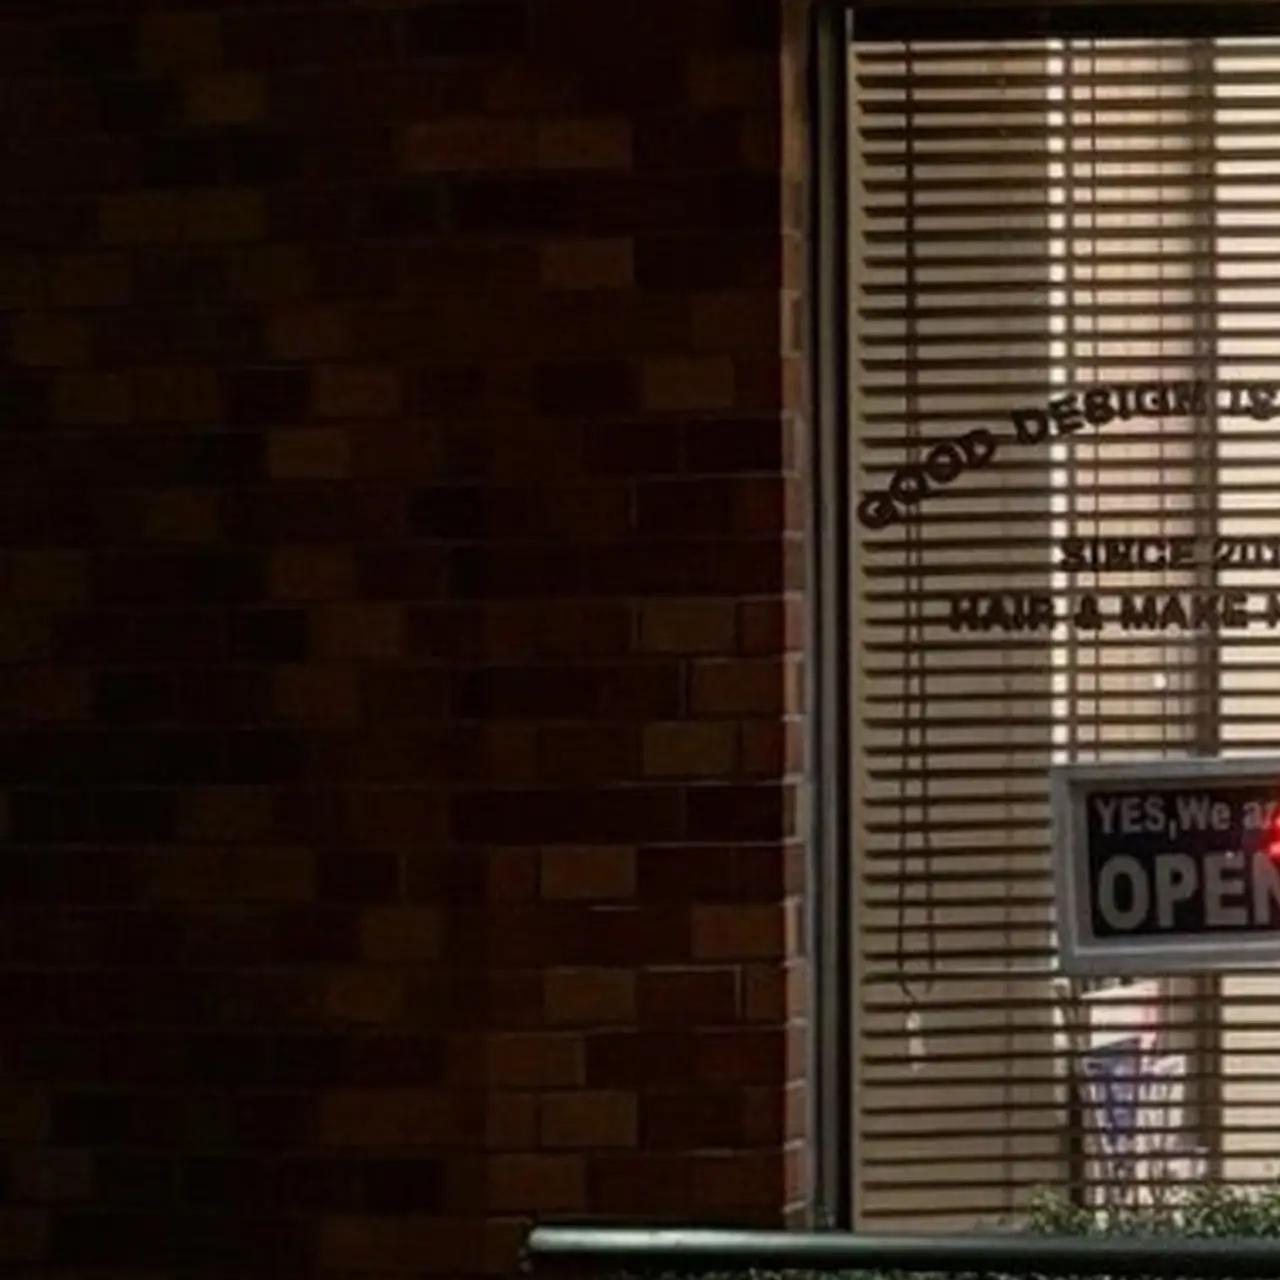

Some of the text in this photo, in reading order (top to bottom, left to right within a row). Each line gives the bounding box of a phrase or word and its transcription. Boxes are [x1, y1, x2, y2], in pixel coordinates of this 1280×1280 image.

[857, 428, 996, 531] GOOD
[1012, 382, 1204, 444] DESIGN
[1228, 382, 1276, 421] IS
[1062, 537, 1196, 572] SINCE
[951, 591, 1055, 631] HAIR
[1121, 591, 1249, 630] MAKE
